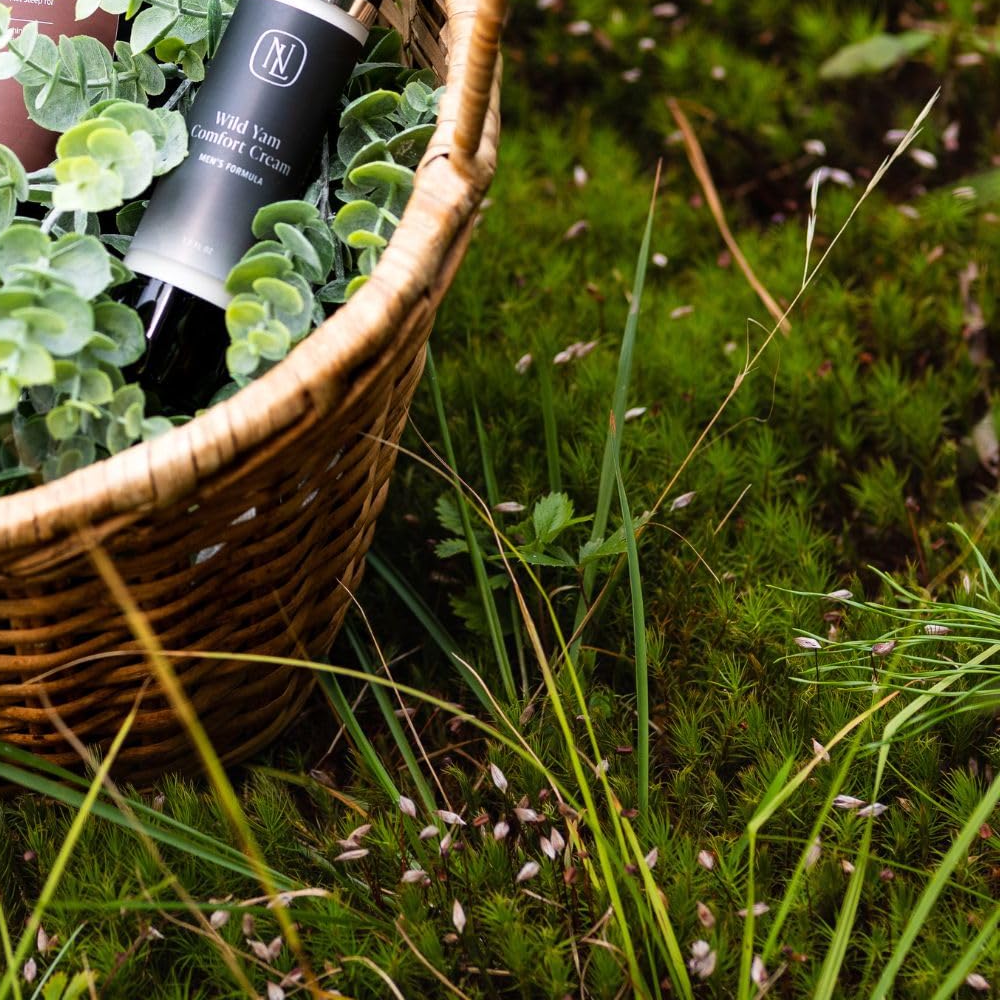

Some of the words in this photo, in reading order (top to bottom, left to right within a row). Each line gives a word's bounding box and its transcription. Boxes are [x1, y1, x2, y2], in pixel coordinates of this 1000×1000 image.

[215, 110, 248, 133] Wild
[252, 124, 281, 150] Yam
[190, 124, 246, 154] Comfort
[249, 144, 292, 177] Cream
[198, 153, 224, 169] MEN'S
[225, 161, 264, 187] FORMULA
